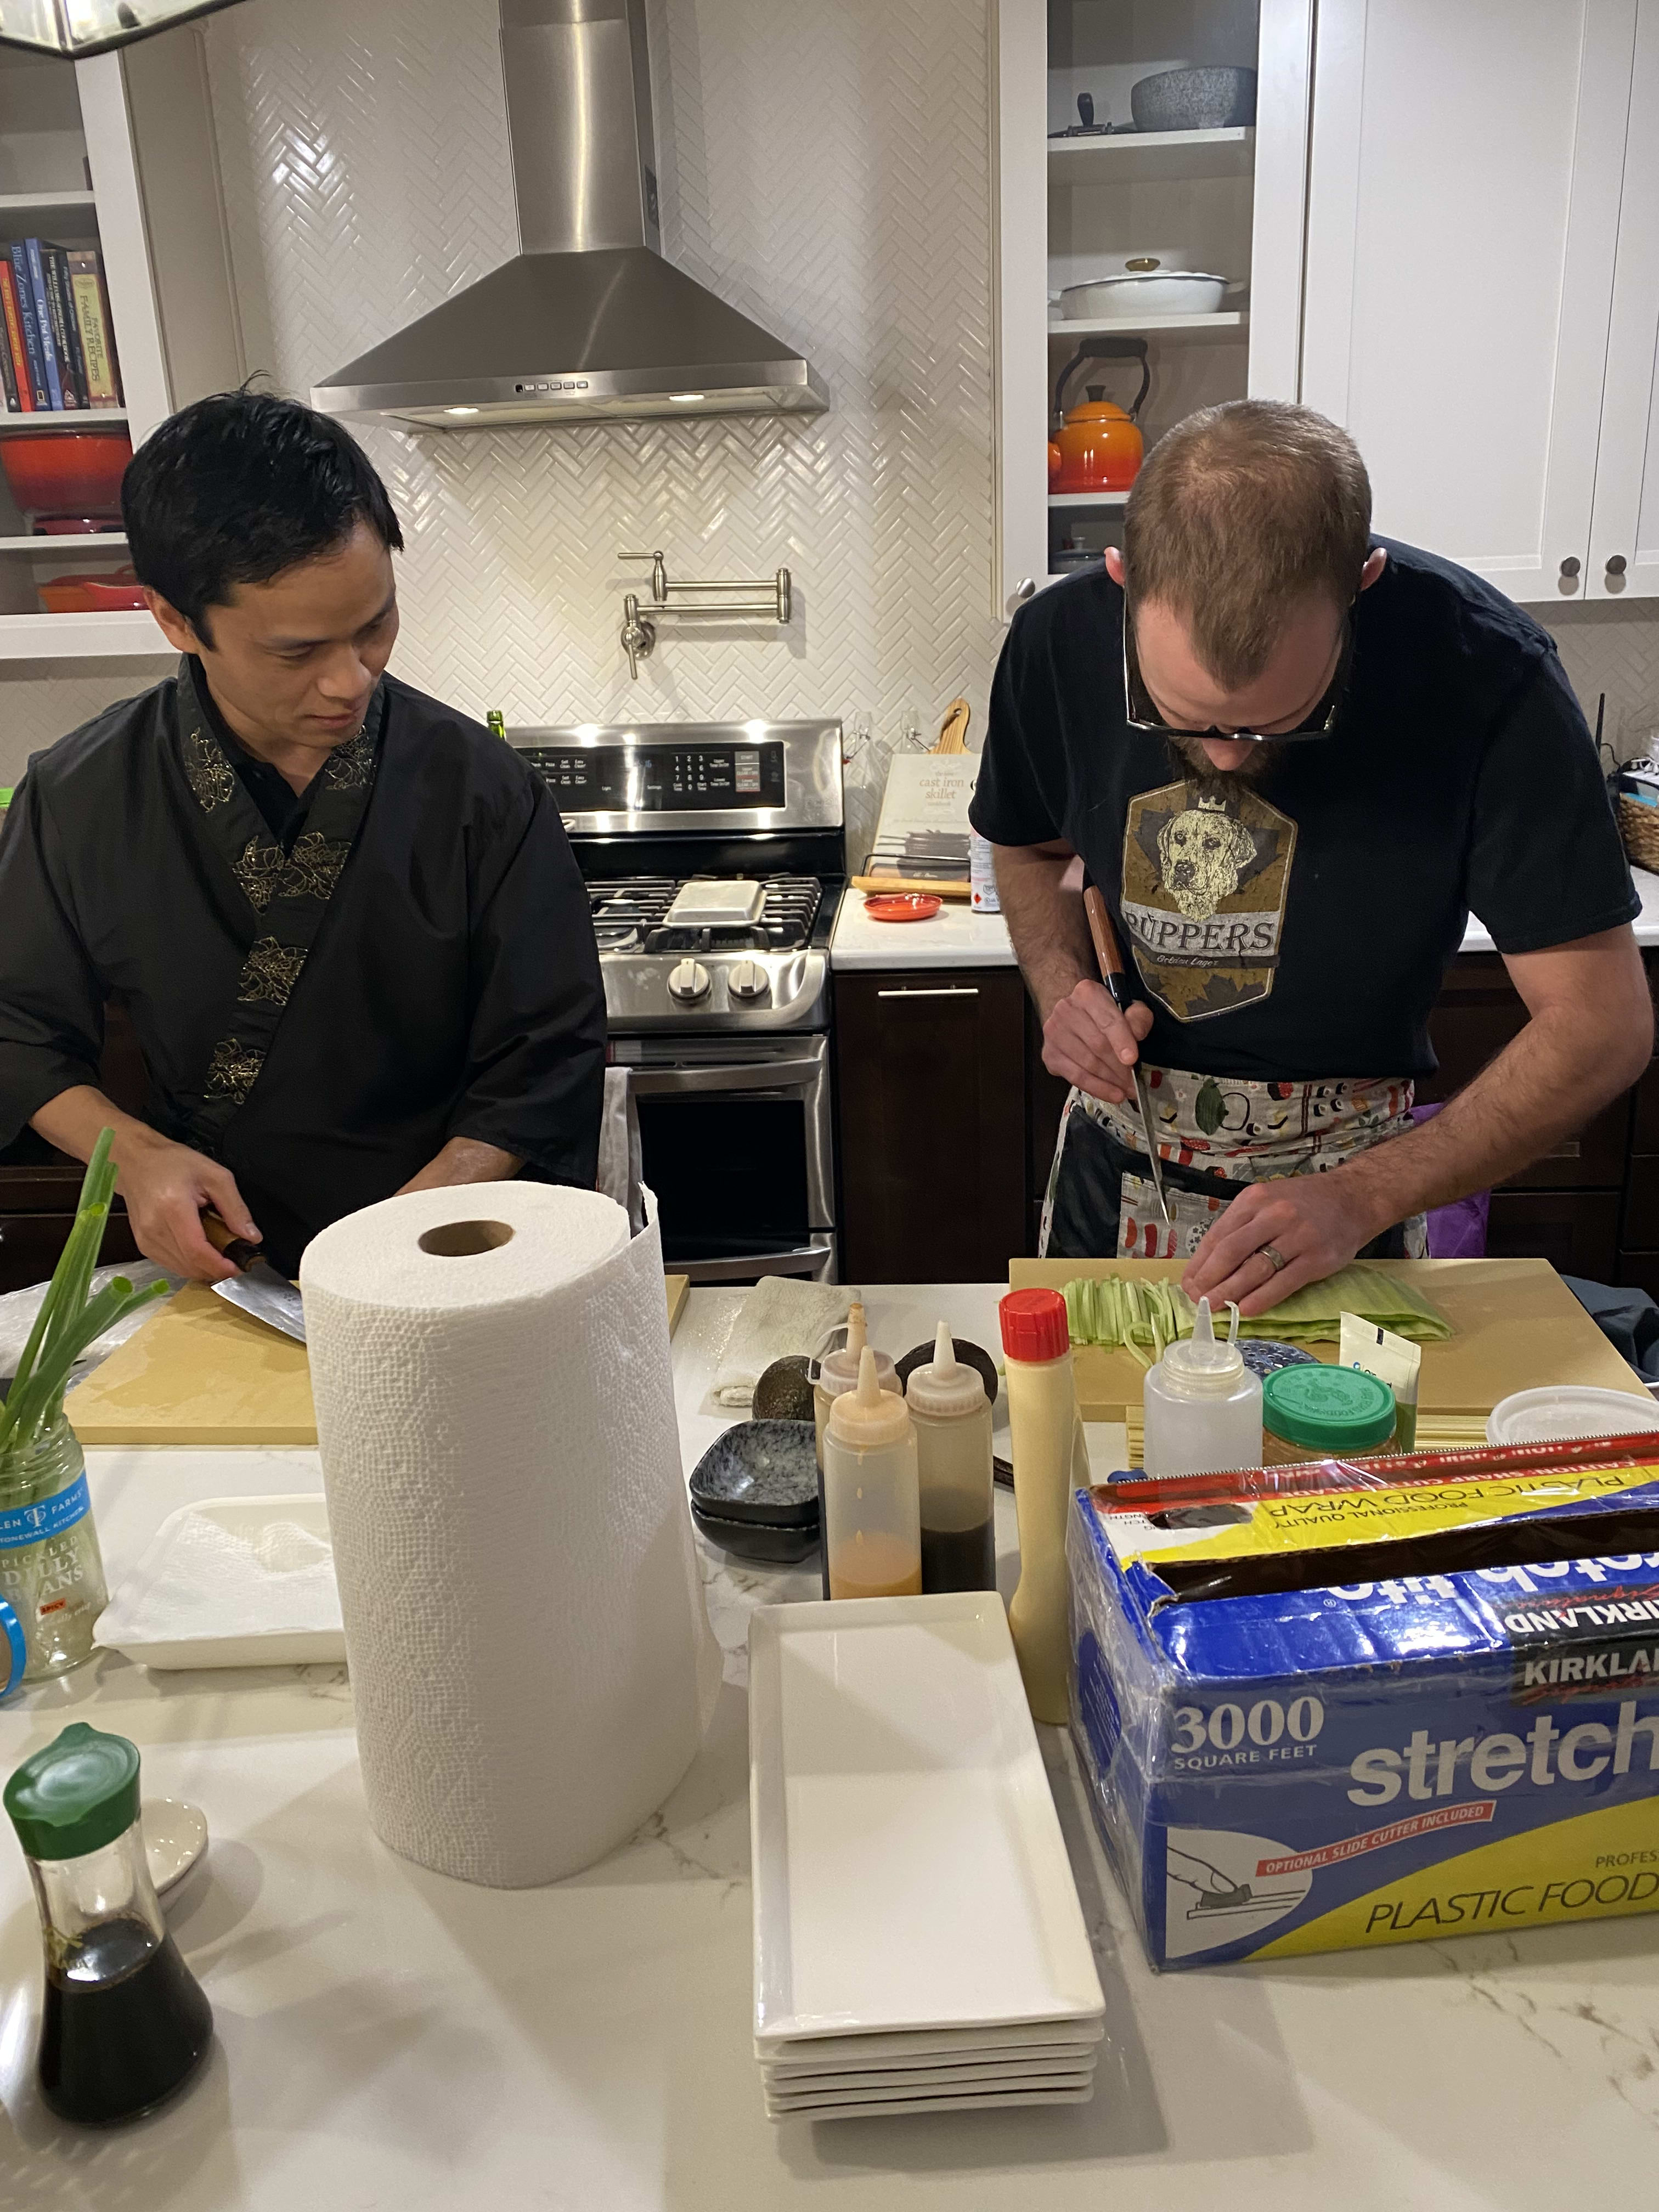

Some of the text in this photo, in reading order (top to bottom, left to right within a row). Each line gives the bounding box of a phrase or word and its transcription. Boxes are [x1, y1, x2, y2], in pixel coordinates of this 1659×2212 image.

[12, 245, 35, 355] Blue Zones Kitchen
[36, 298, 46, 318] One
[40, 319, 48, 335] Pot
[80, 294, 93, 336] FAMILY
[42, 335, 53, 362] Meals
[91, 317, 103, 359] FAVORITE
[86, 337, 100, 381] RECIPES
[919, 776, 964, 787] cast iron
[925, 787, 957, 799] skillet
[1125, 911, 1274, 951] PUPPERS
[1157, 955, 1219, 968] Golden Lager
[1451, 1470, 1525, 1483] SHARP
[1532, 1460, 1636, 1476] CAUTION:
[52, 1490, 82, 1514] FARMS
[1270, 1476, 1624, 1517] PLASTIC FOOD WRAP
[1282, 1486, 1354, 1498] BLADE
[1276, 1502, 1468, 1529] PROFESSIONAL QUALITY
[2, 1536, 77, 1568] PICKLED
[3, 1546, 78, 1585] DILLY
[42, 1601, 64, 1613] SPICY
[1171, 1696, 1324, 1753] 3000
[1173, 1744, 1317, 1771] SQUARE FEET
[1347, 1700, 1659, 1807] stretch
[1266, 1805, 1485, 1874] OPTIONAL SLIDE CUTTER INCLUDED
[1594, 1849, 1659, 1868] PROFES
[1365, 1872, 1659, 1933] PLASTIC FOOD
